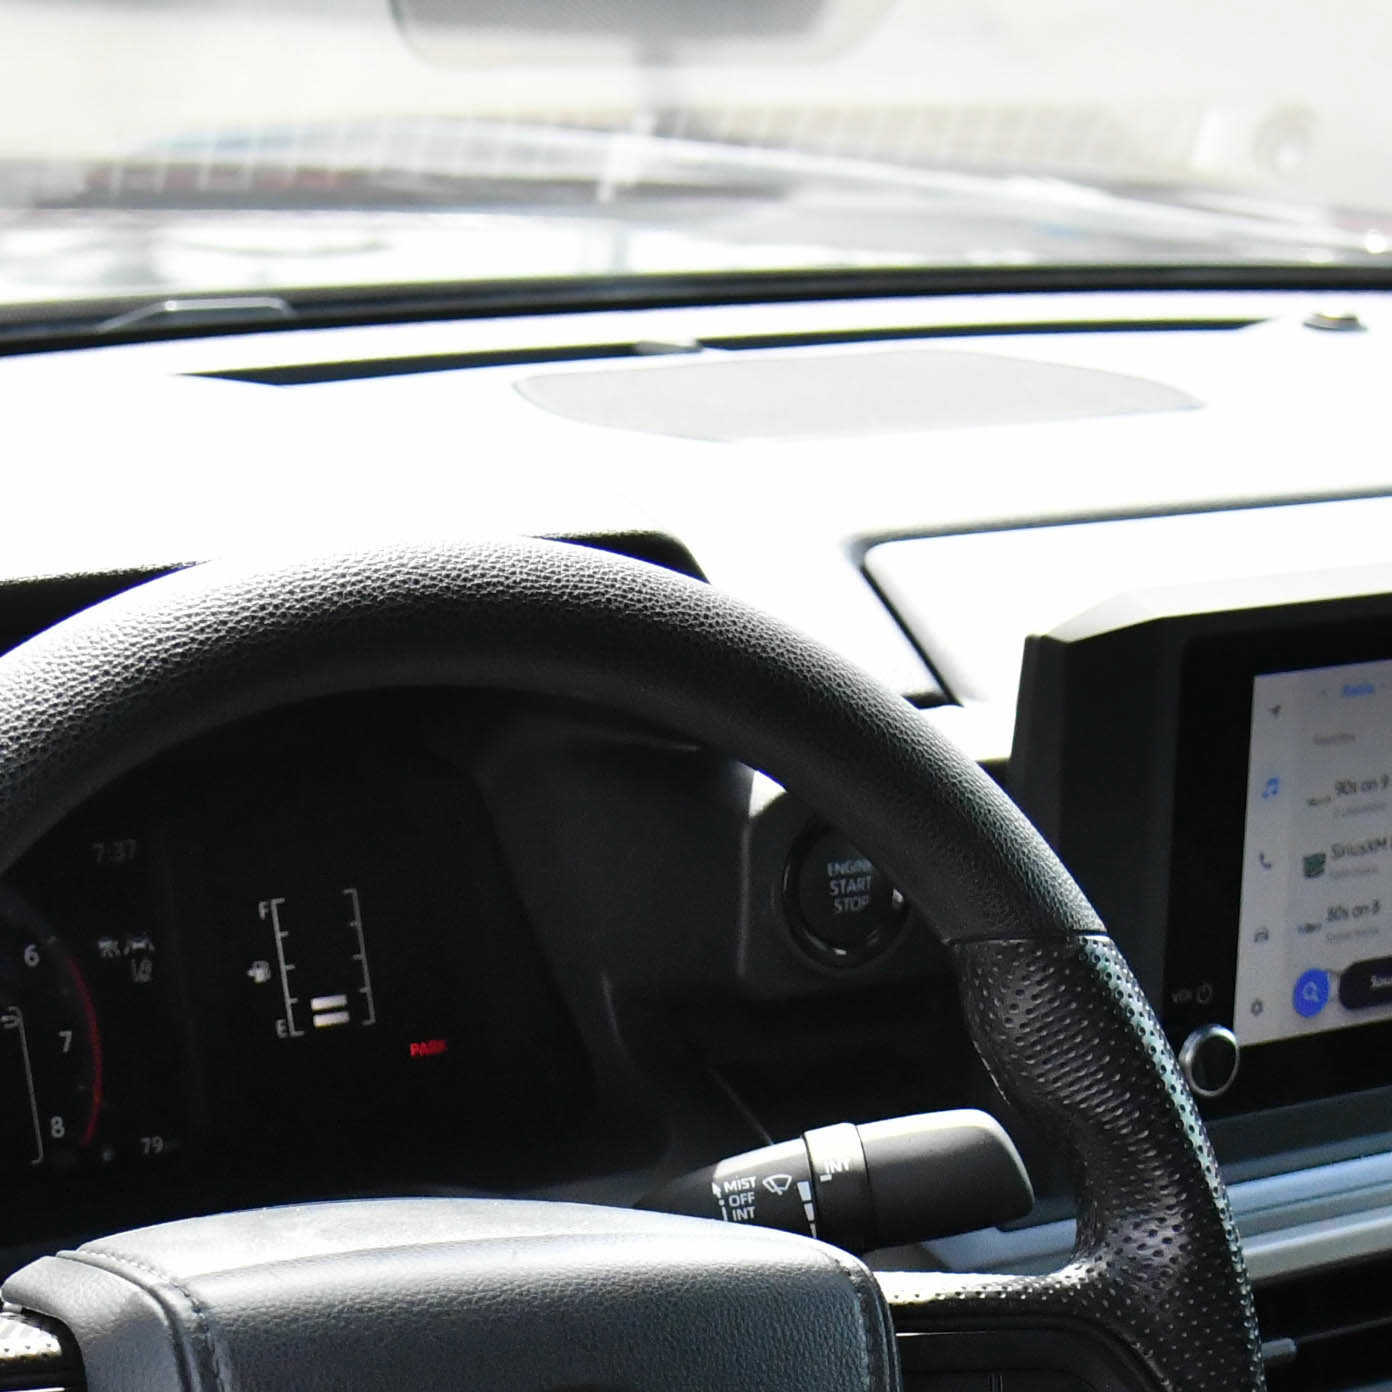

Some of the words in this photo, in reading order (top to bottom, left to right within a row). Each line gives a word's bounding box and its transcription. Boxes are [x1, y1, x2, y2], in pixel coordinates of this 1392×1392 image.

[829, 876, 872, 896] START
[258, 901, 270, 920] F
[833, 895, 869, 914] STOP
[23, 943, 40, 967] 6
[275, 1018, 289, 1040] E
[57, 1029, 73, 1053] 7
[50, 1115, 65, 1139] 8
[824, 1159, 851, 1175] INT
[729, 1192, 755, 1208] OFF
[732, 1207, 756, 1221] INT
